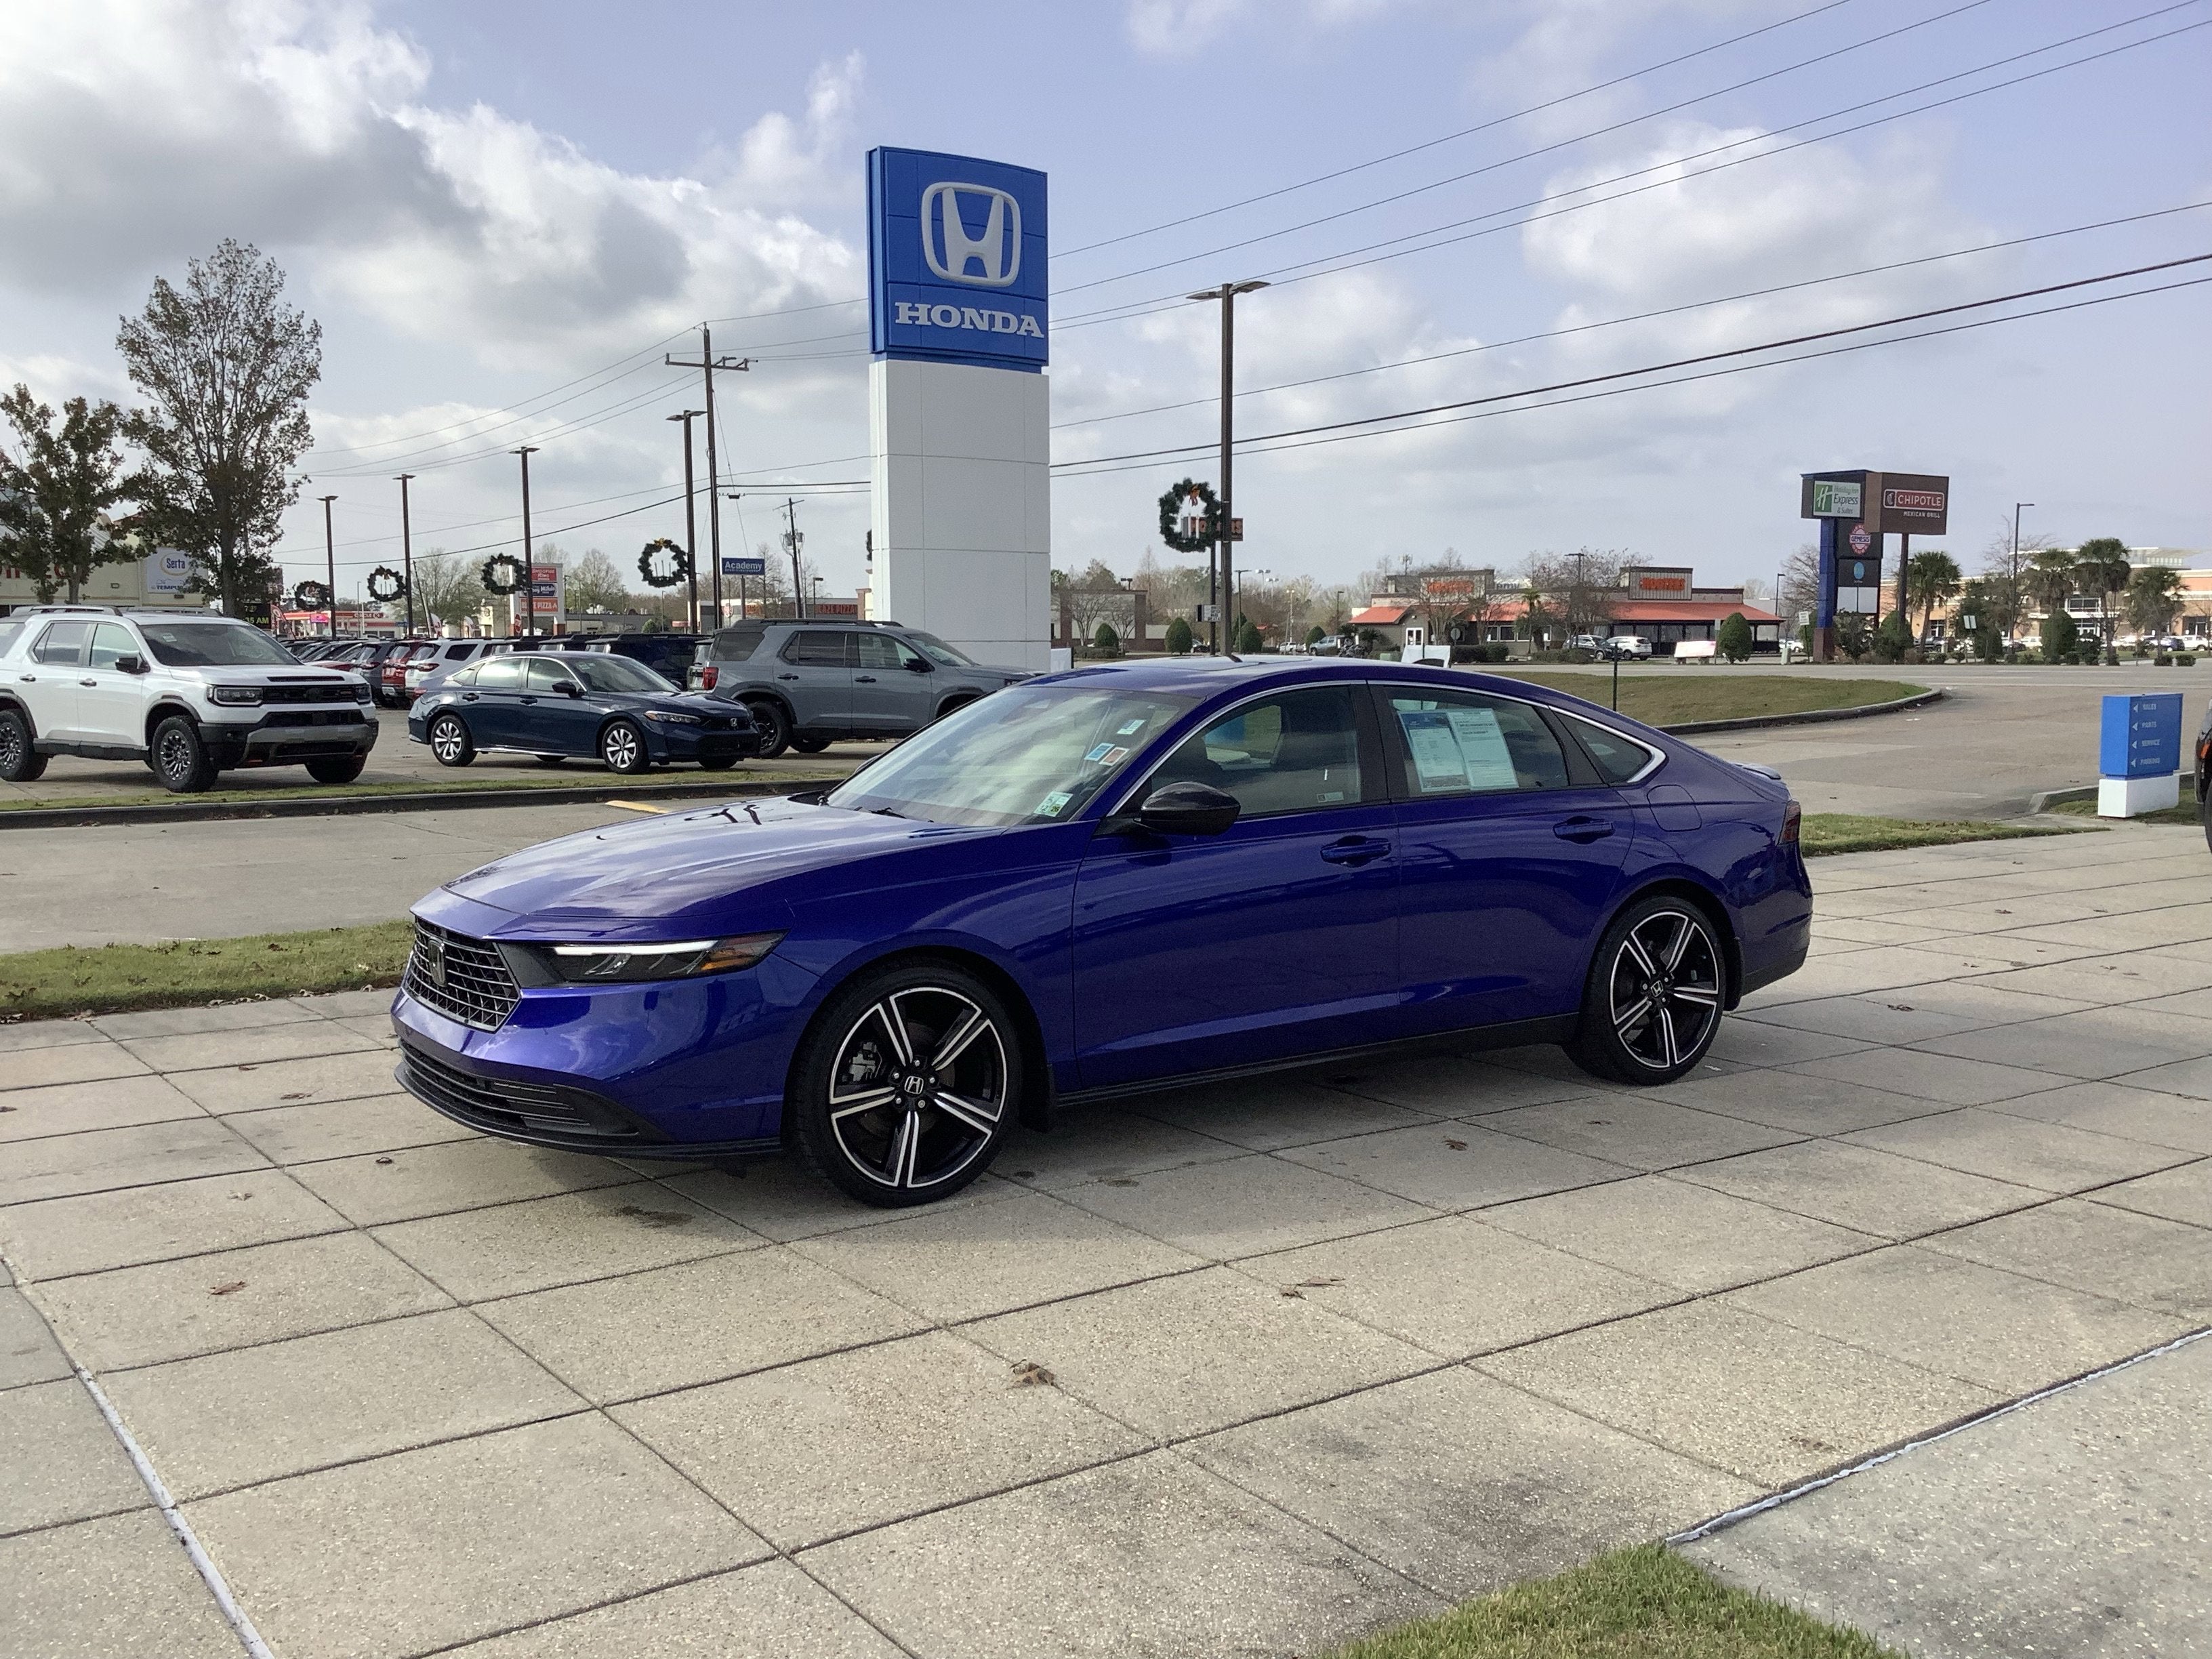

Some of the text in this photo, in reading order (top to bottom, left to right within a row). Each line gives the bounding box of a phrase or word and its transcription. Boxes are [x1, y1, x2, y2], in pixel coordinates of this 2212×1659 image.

[895, 302, 1044, 338] HONDA
[1834, 493, 1859, 506] Express
[1898, 494, 1942, 507] CHIPOTLE
[166, 558, 186, 569] Serta
[724, 560, 762, 572] Academy
